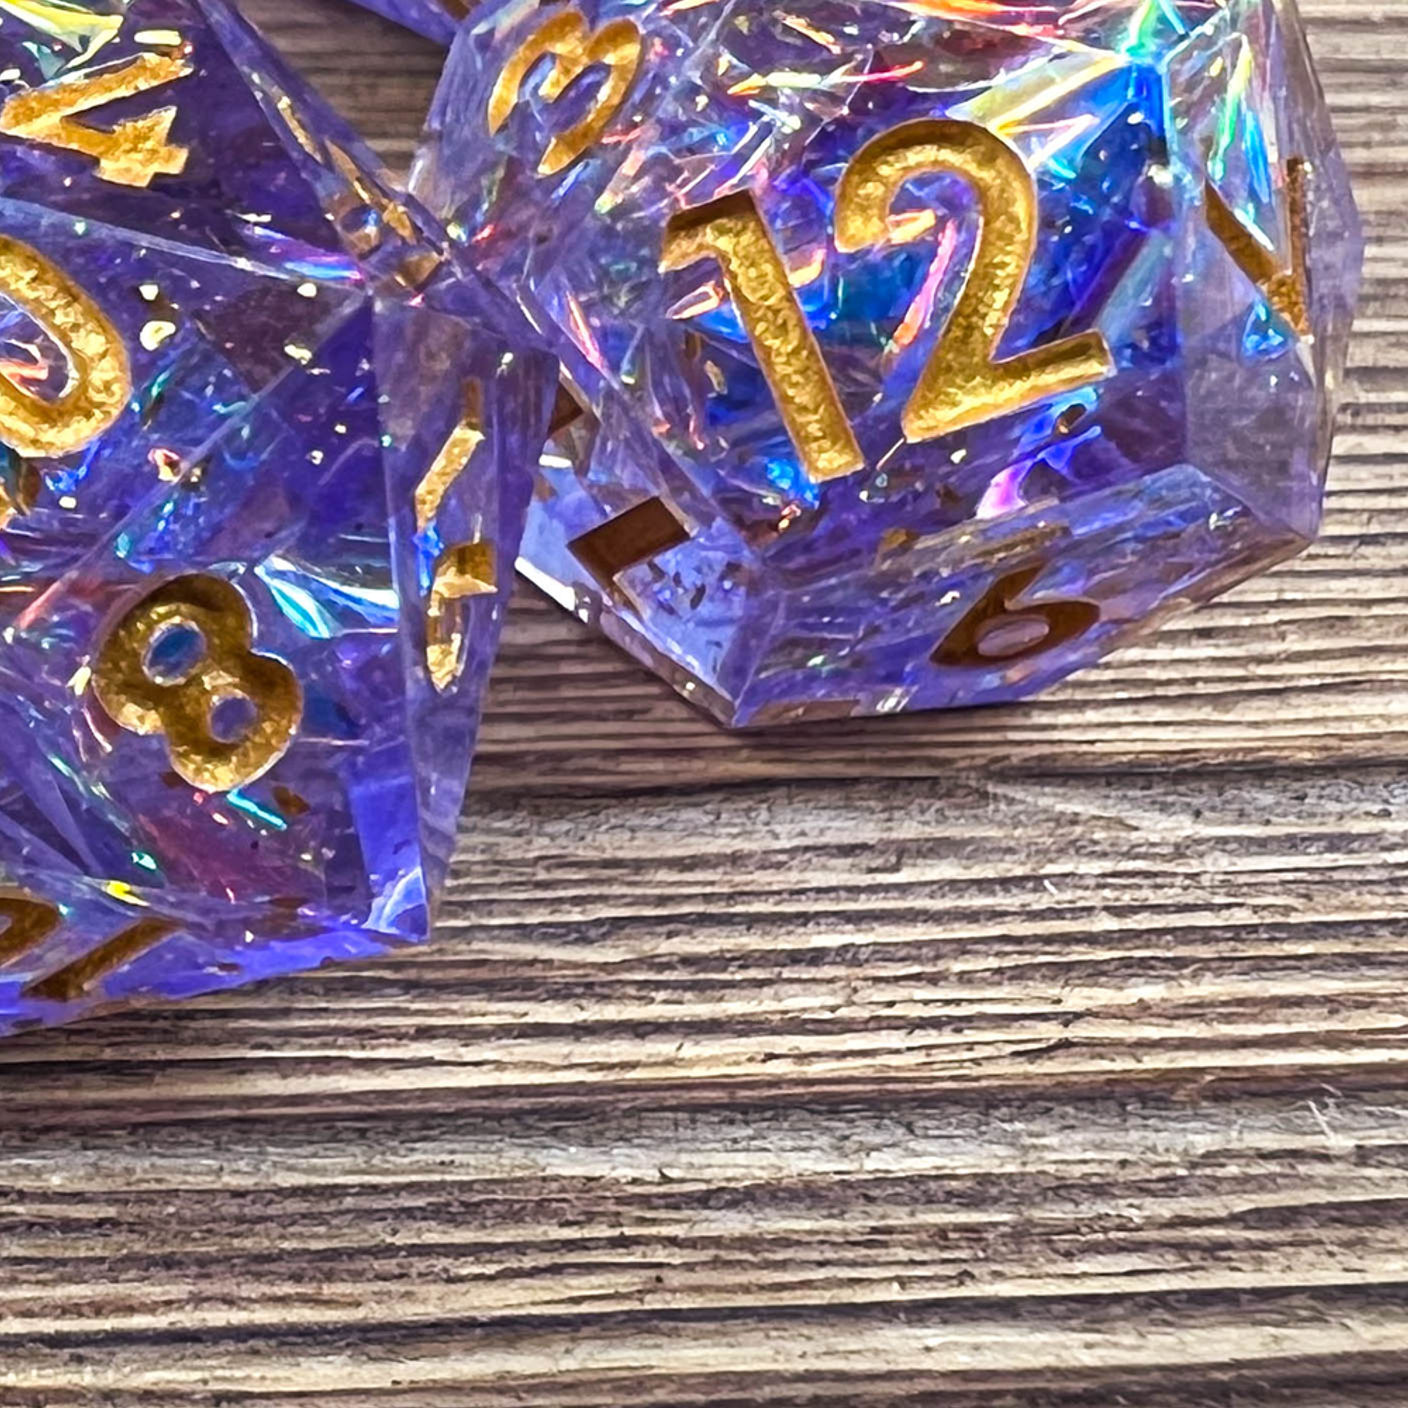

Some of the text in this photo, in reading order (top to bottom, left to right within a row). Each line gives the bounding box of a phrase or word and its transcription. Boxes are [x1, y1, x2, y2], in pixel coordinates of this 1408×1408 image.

[488, 11, 643, 174] 3
[660, 118, 1114, 483] 12
[92, 574, 305, 792] 8
